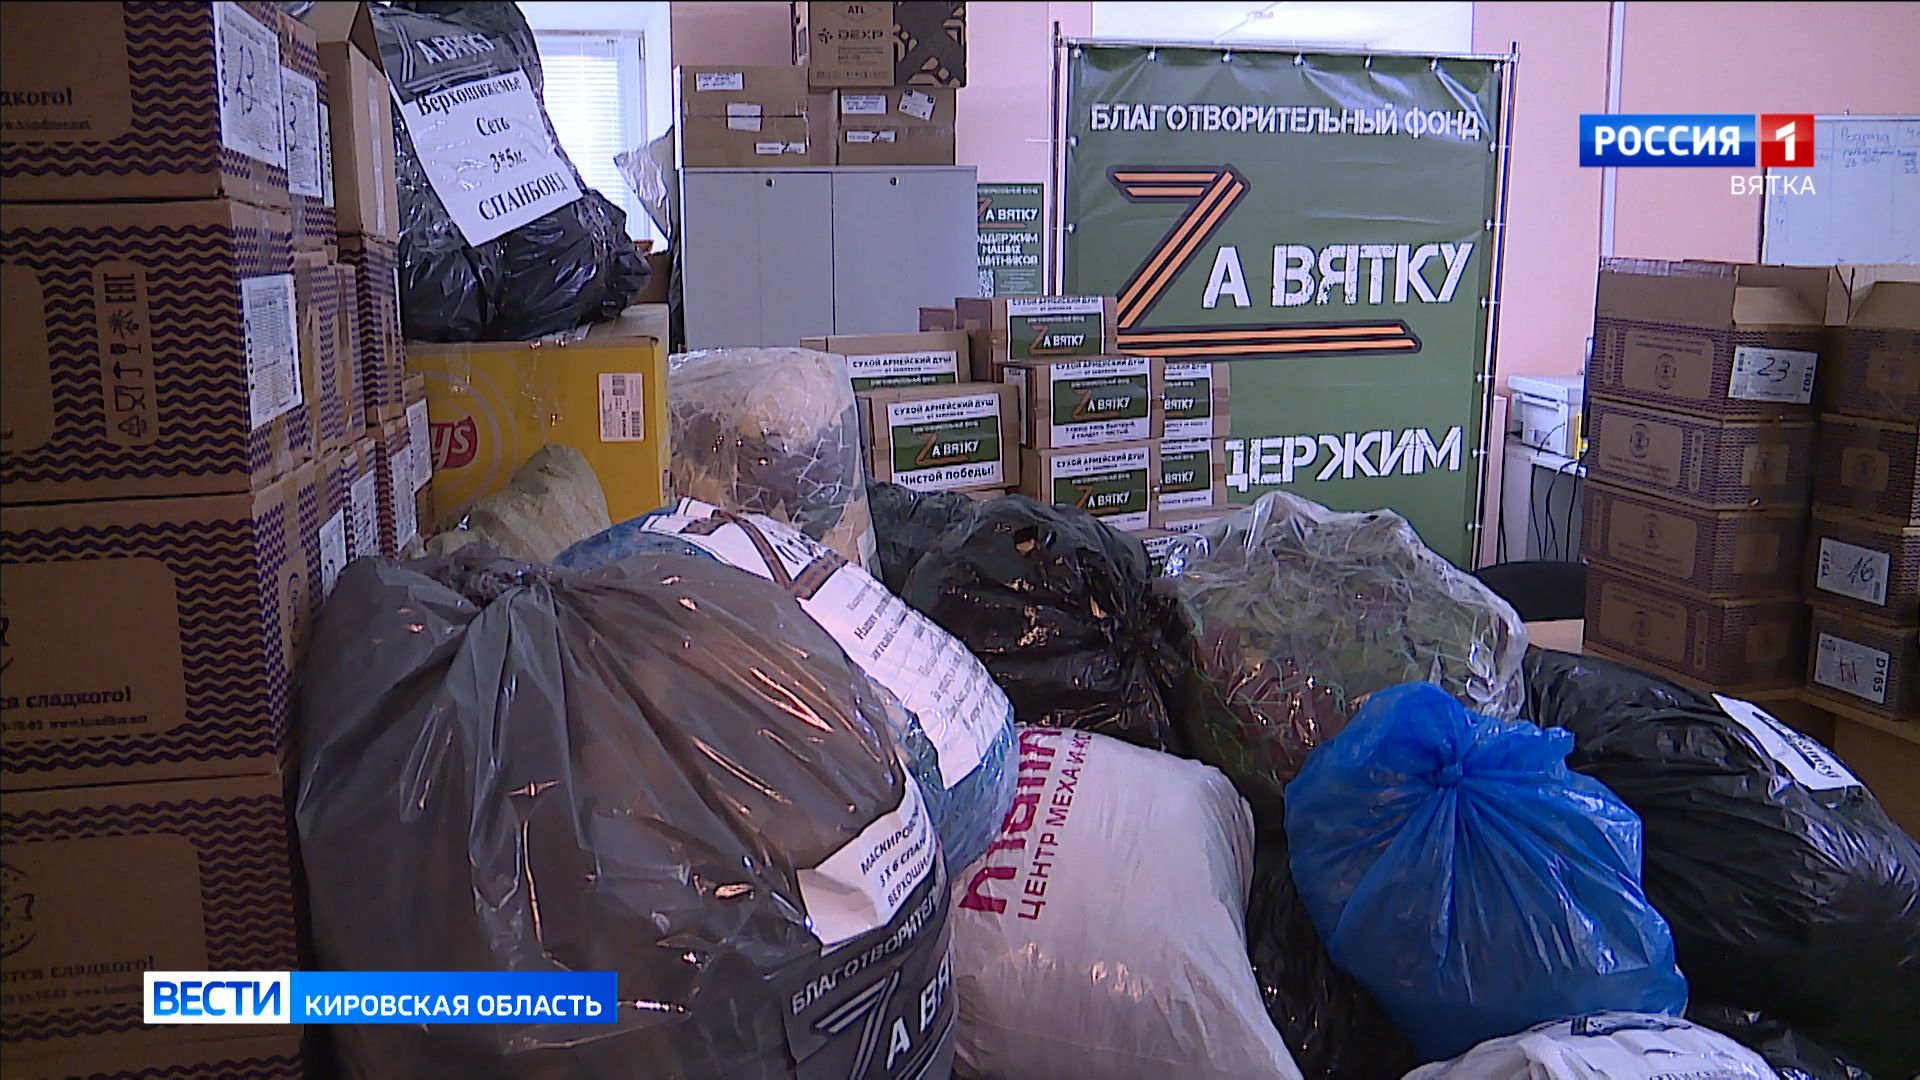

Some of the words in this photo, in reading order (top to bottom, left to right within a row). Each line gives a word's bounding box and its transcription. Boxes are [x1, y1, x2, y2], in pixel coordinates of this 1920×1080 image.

[0, 87, 73, 107] дкого!
[476, 115, 511, 137] Сеть
[1090, 103, 1398, 136] БЛАГОТВОРИТЕЛЬНЫЙ
[478, 171, 569, 221] СПАНБОНД
[997, 208, 1038, 221] ВЯТКУ
[1271, 242, 1475, 308] ВЯТКУ
[1053, 334, 1085, 347] ВЯТКУ
[1756, 357, 1791, 383] 23
[894, 405, 923, 416] СУХОЙ
[974, 398, 994, 408] ДУШ
[943, 440, 980, 456] ВЯТКУ
[1225, 426, 1462, 492] ДЕРЖИМ
[1097, 490, 1130, 506] ВЯТКУ
[1848, 556, 1875, 584] 16
[1872, 657, 1887, 693] D165
[26, 685, 132, 711] сладкого!
[1017, 832, 1059, 921] ЦЕНТР
[791, 894, 935, 1016] БЛАГОТВОРИТЕЛ
